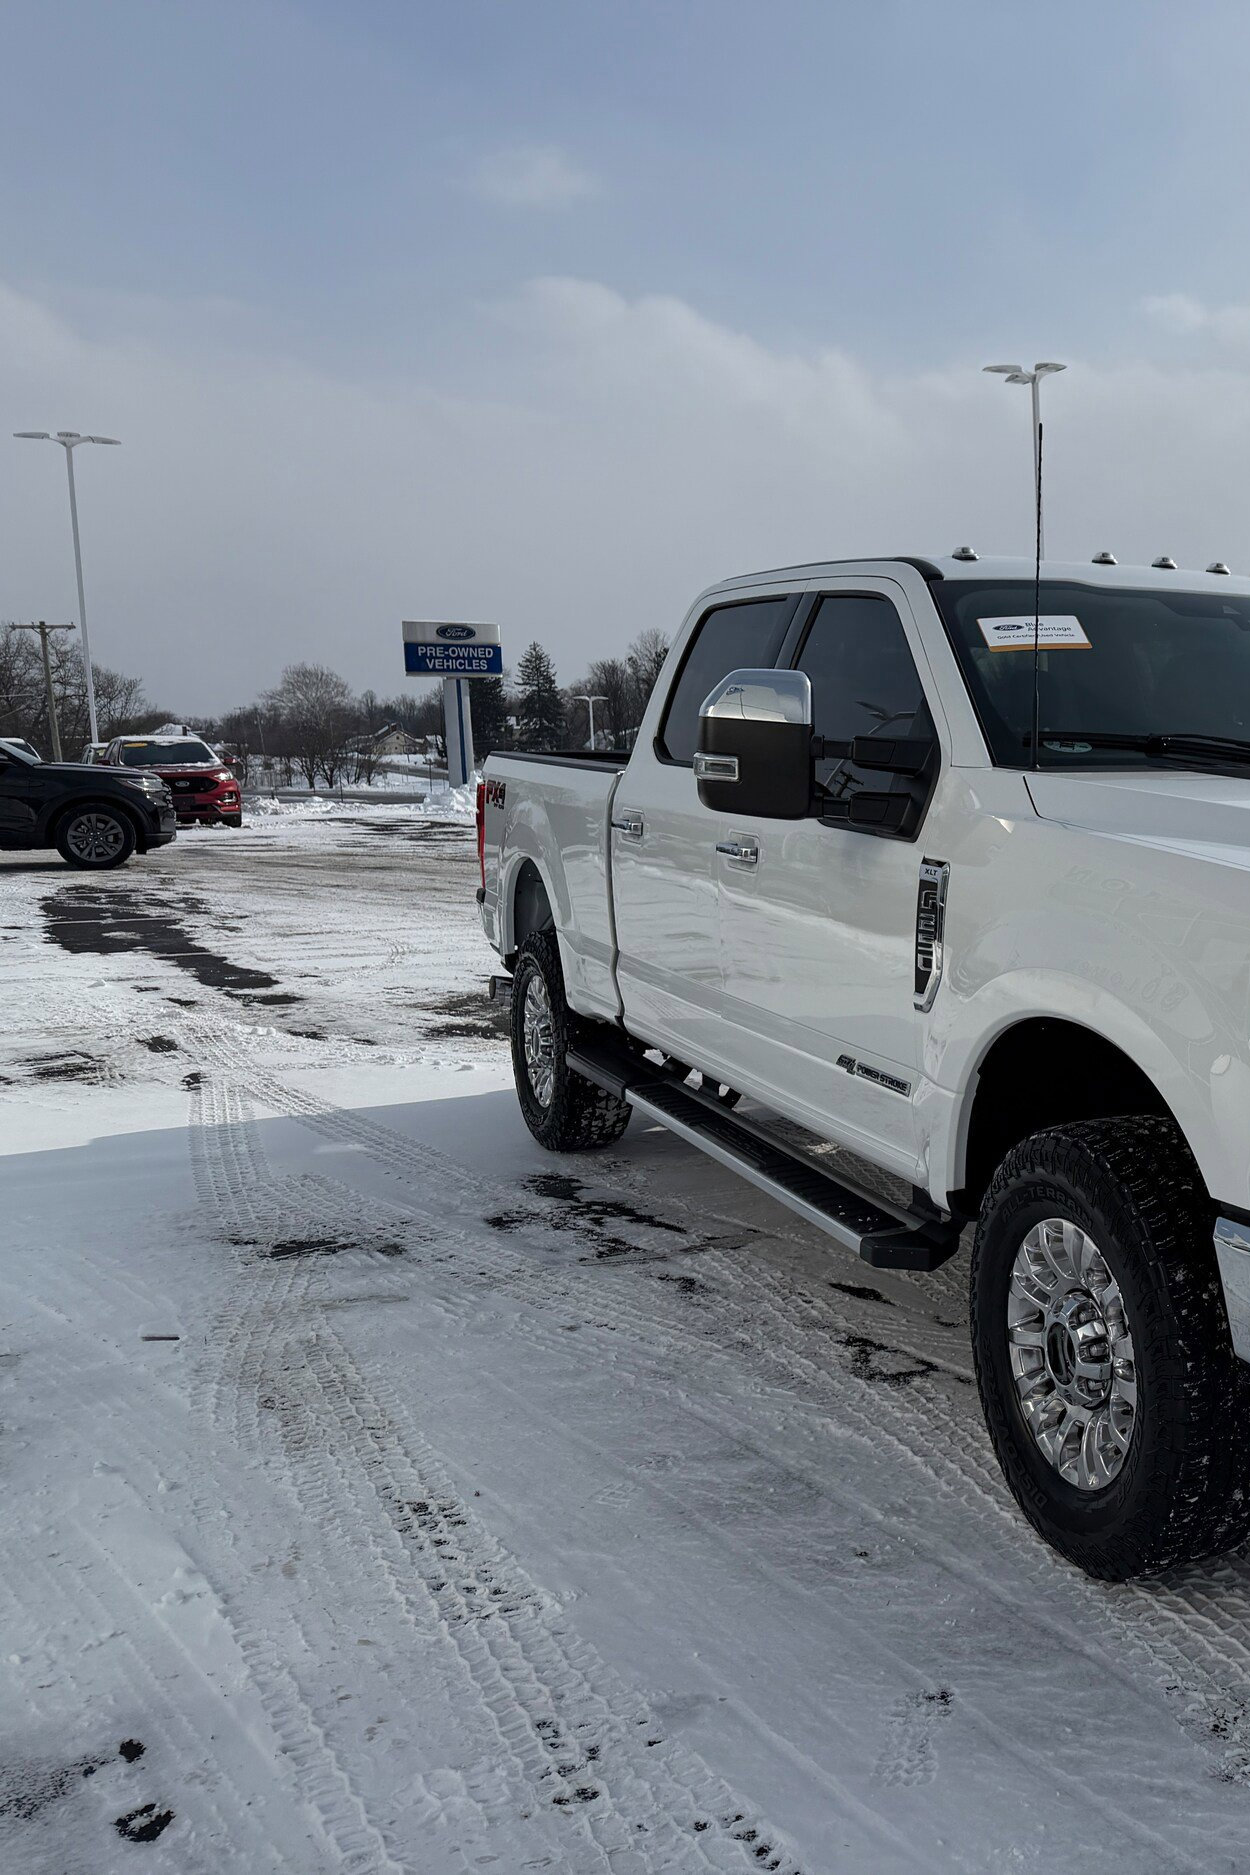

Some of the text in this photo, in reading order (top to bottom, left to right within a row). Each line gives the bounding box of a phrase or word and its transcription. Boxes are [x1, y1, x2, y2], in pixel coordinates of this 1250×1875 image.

[444, 627, 469, 638] Ford
[417, 646, 494, 658] PRE-OWNED
[425, 658, 488, 670] VEHICLES
[924, 868, 938, 876] XLT
[856, 1063, 909, 1092] POWER STROKE
[1001, 1185, 1093, 1229] ALL-TERRAIN
